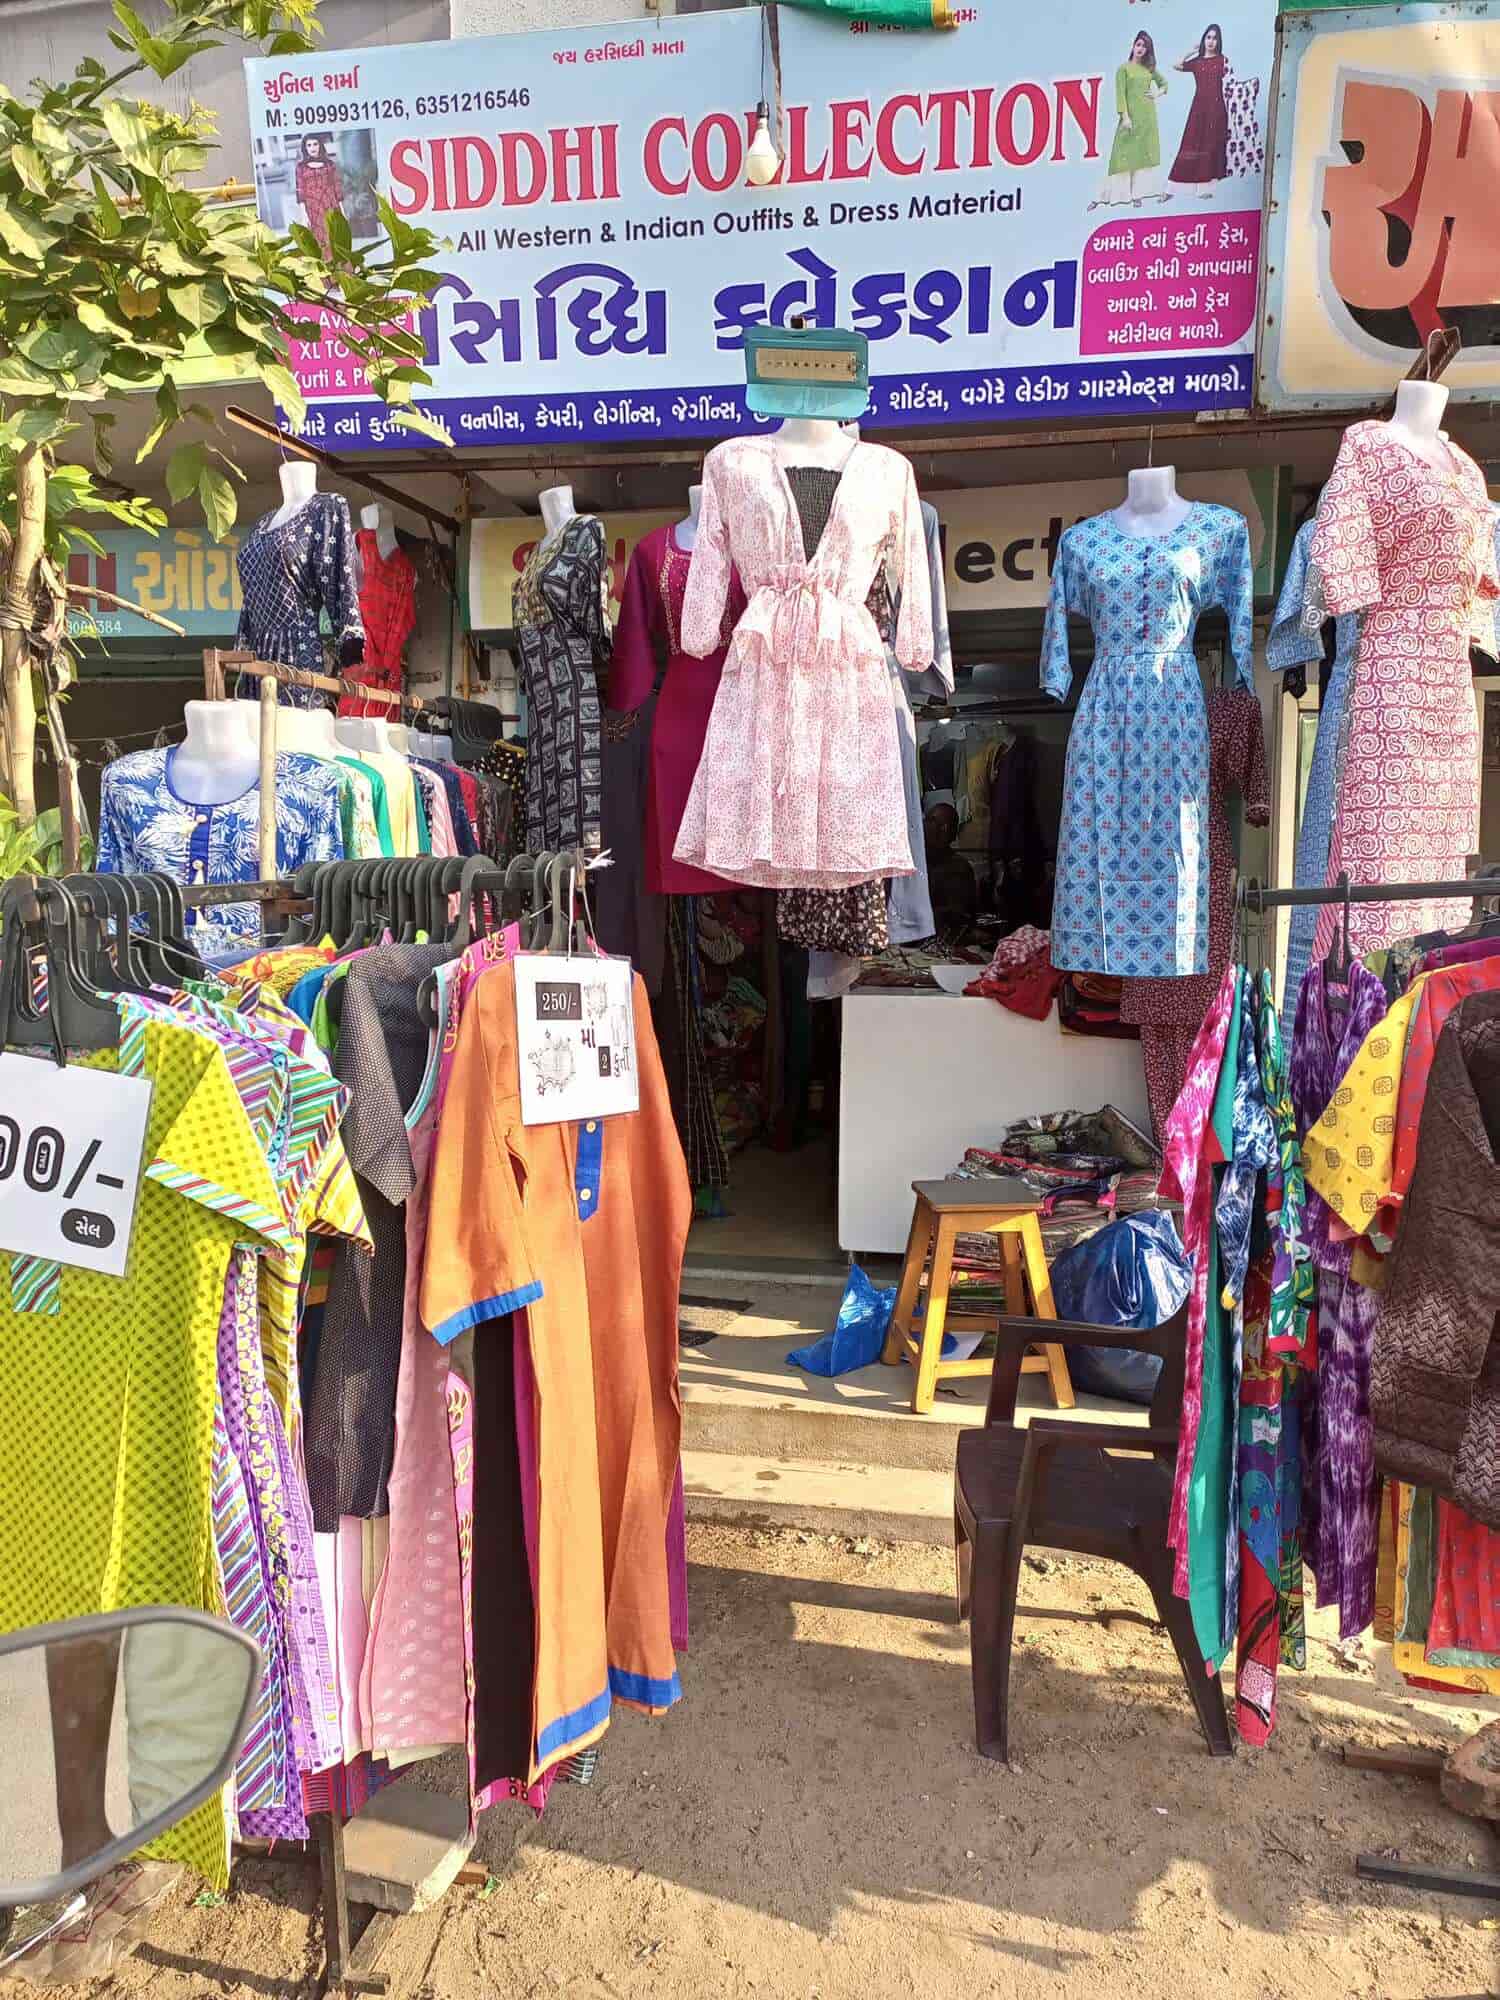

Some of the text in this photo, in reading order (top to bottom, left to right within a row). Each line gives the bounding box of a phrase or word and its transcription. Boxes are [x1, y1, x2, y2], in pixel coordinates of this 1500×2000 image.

[552, 50, 577, 64] જય
[652, 39, 684, 56] માતા
[264, 64, 360, 103] સુનિલ શર્મા
[266, 88, 530, 128] M: 9099931126, 6351216546
[389, 123, 621, 216] SIDDHI
[457, 188, 1022, 252] All Western & Indian Outfits & Dress Material
[1093, 229, 1135, 252] અમારે
[1142, 227, 1167, 249] ત્યાં
[1218, 222, 1249, 249] ડ્રેસ,
[1088, 254, 1253, 284] બ્લાઉઝ સીવી આપવામાં
[1107, 286, 1230, 313] આવશે. અને ડ્રેસ
[1107, 318, 1224, 345] મટીરીયલ મળશે.
[299, 341, 321, 361] XL
[335, 368, 348, 388] &
[960, 378, 1006, 404] વગેરે
[1015, 376, 1069, 402] લેડીઝ
[1184, 364, 1247, 394] મળશે.
[334, 411, 362, 437] ત્યાં
[460, 404, 526, 432] વનપીસ,
[535, 403, 584, 430] કેપરી,
[542, 992, 577, 1015] 250/-
[75, 1216, 101, 1238] સેલ
